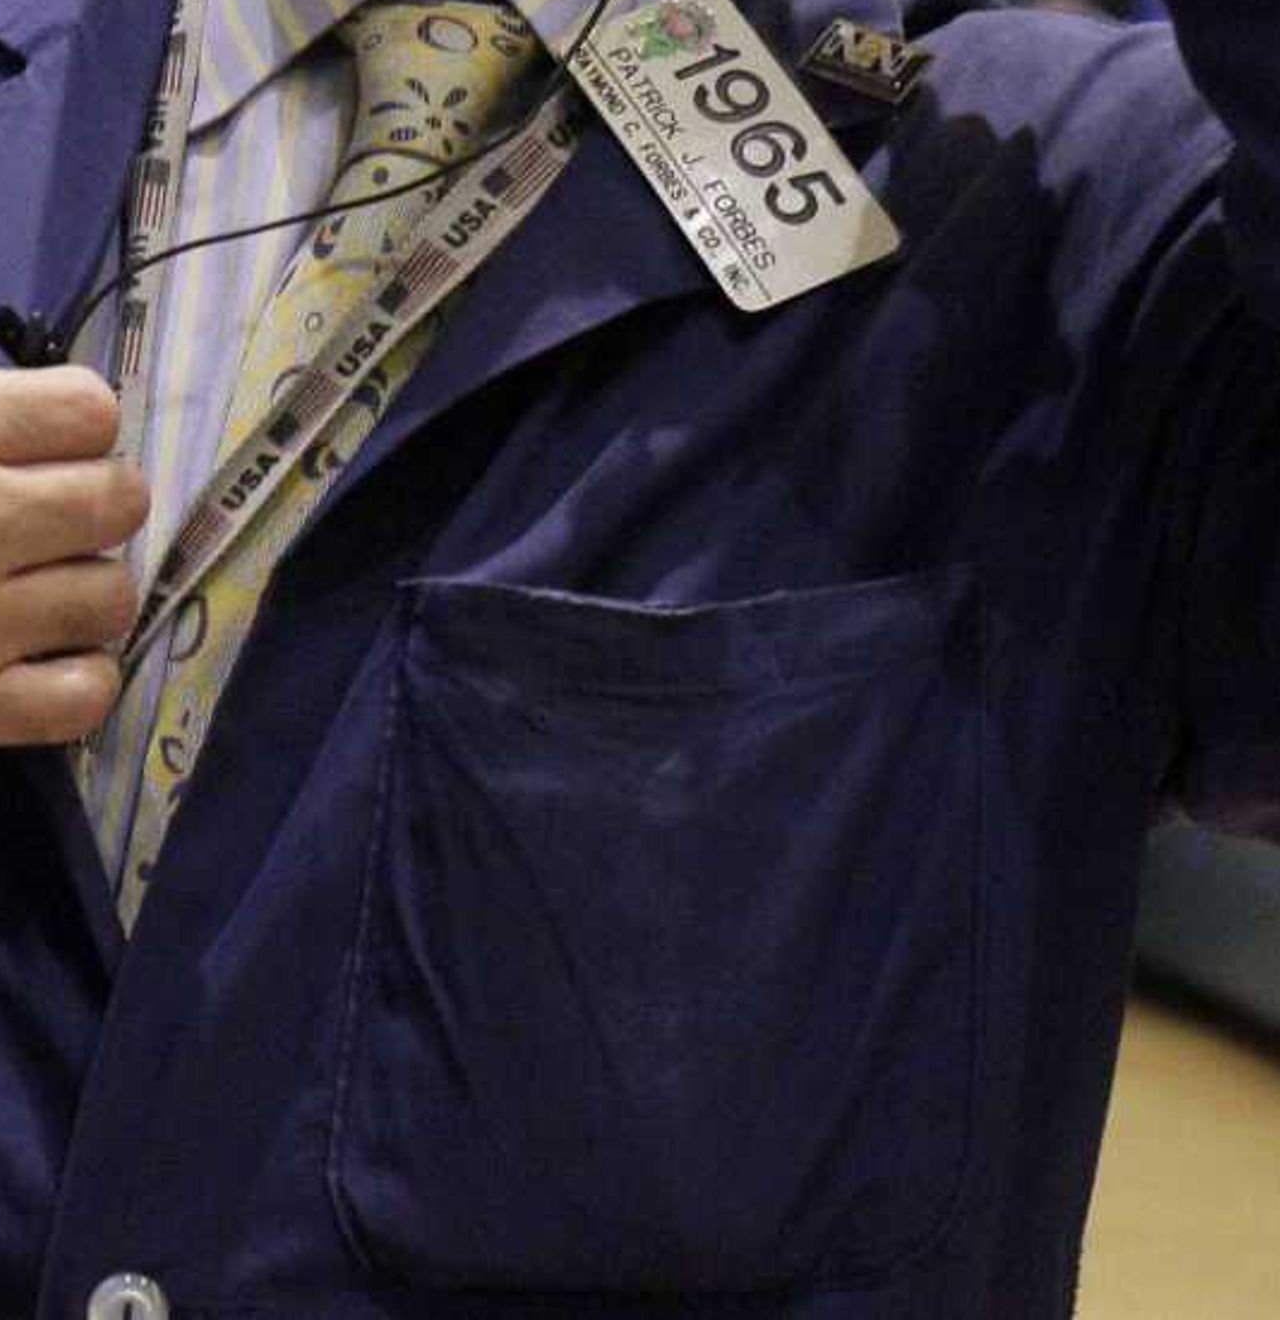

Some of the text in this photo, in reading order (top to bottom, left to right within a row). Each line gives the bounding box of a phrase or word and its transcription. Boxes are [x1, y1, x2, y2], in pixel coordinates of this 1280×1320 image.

[608, 46, 683, 140] PATRICK
[703, 179, 777, 272] FORBES
[673, 43, 847, 227] 1965
[639, 141, 688, 201] FORBES
[442, 198, 497, 249] USA
[335, 320, 392, 377] USA
[220, 451, 281, 511] USA
